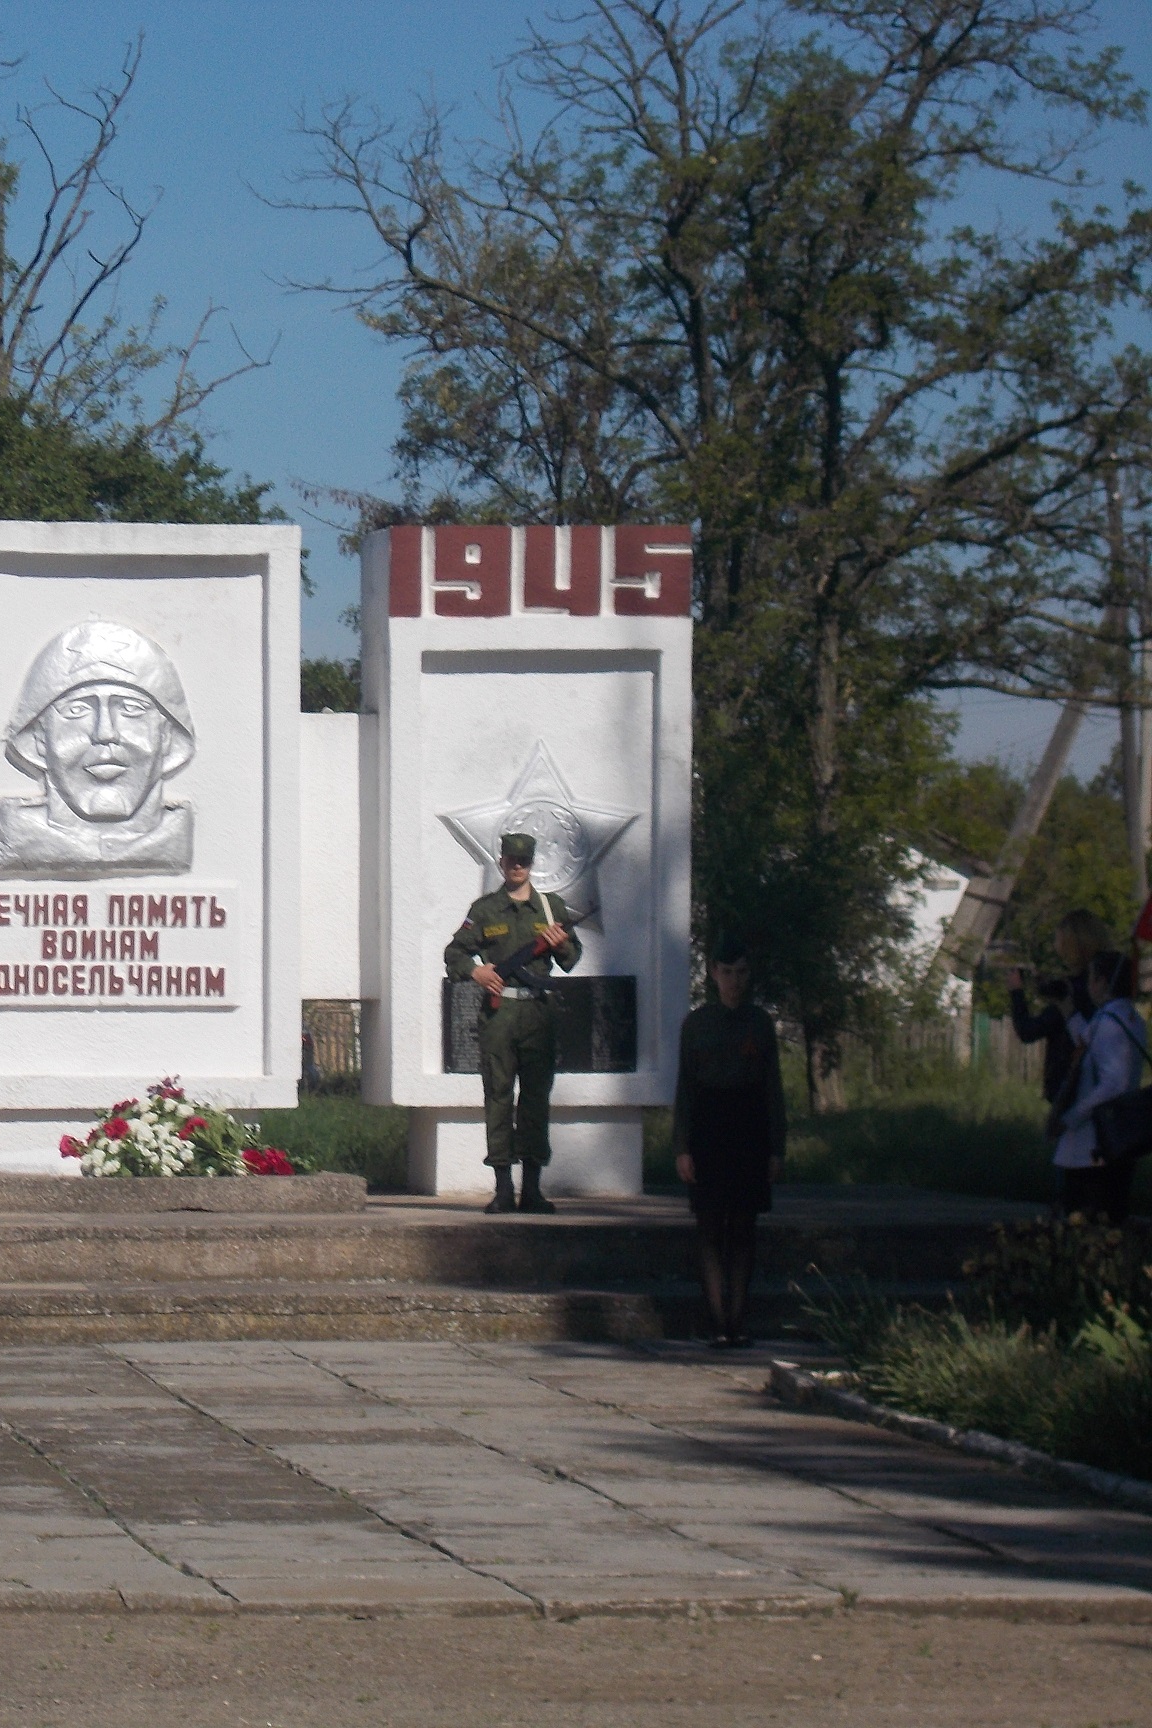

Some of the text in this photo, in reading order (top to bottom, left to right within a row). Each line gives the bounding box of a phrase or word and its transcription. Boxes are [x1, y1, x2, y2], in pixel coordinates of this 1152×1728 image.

[389, 525, 692, 617] 1945
[108, 894, 227, 929] ПАМЯТЬ
[41, 930, 159, 961] ВОИНАМ
